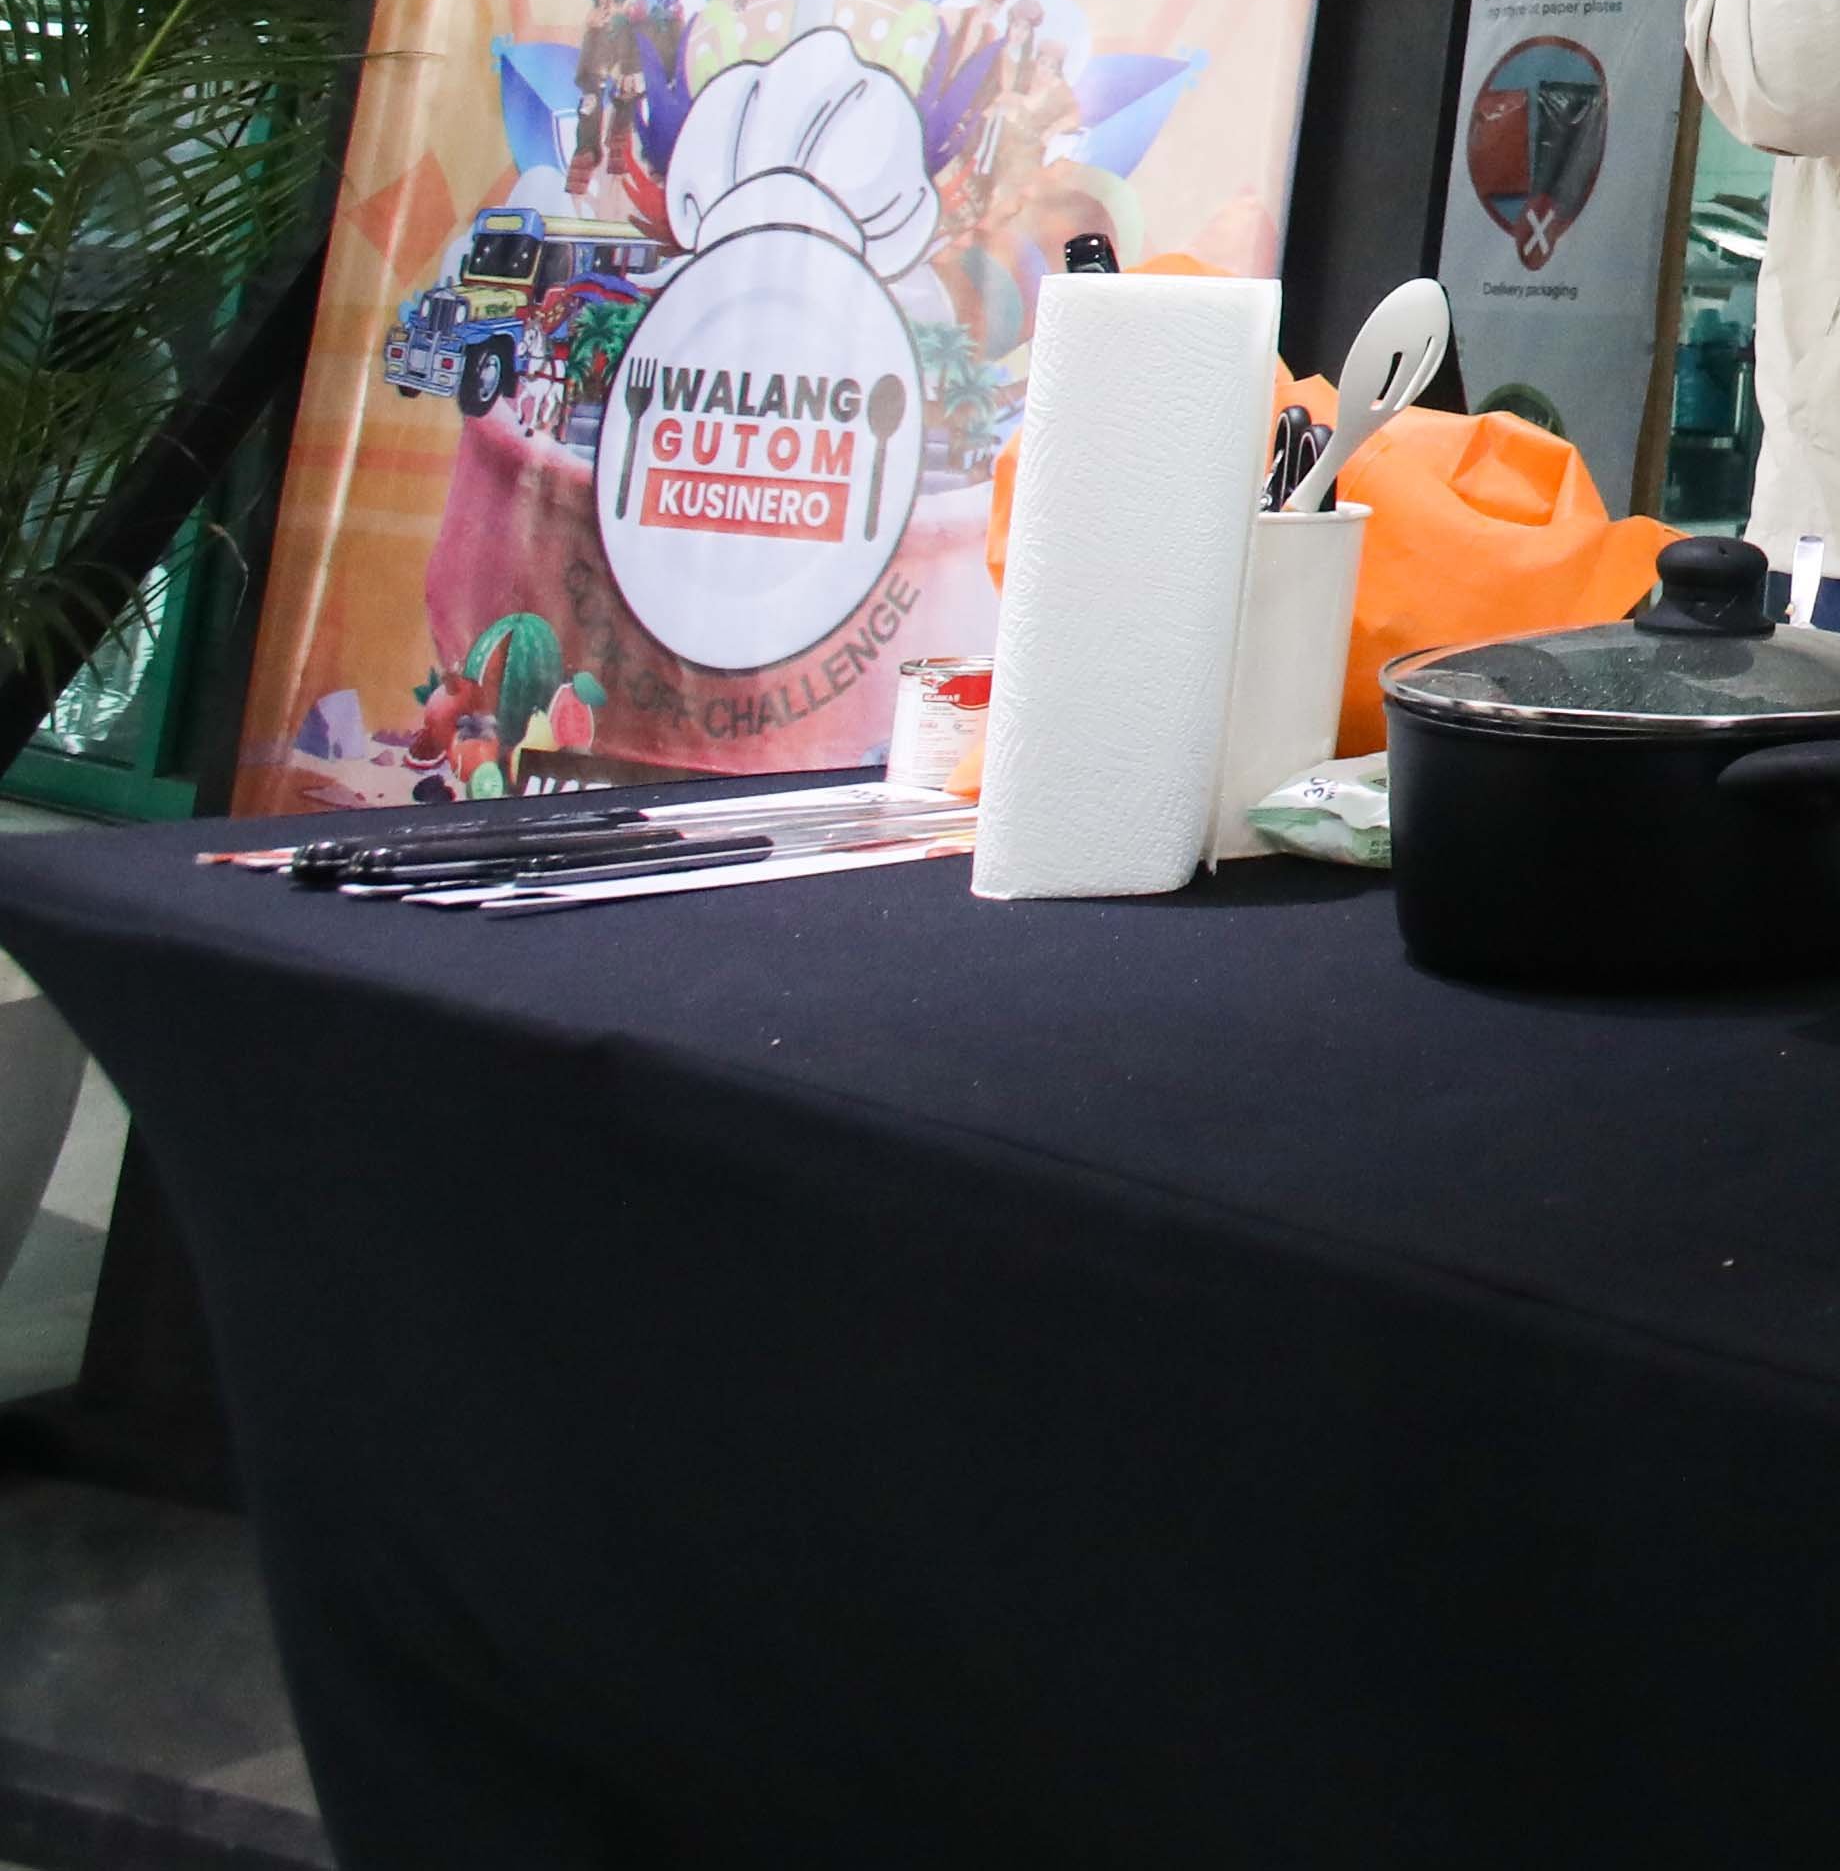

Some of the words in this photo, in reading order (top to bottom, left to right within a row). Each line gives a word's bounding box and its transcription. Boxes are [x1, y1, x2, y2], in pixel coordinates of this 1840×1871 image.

[1542, 2, 1579, 17] paper
[660, 366, 862, 423] WALANG
[651, 418, 857, 477] GUTOM
[657, 479, 831, 527] KUSINERO
[702, 571, 921, 740] CHALLENGE
